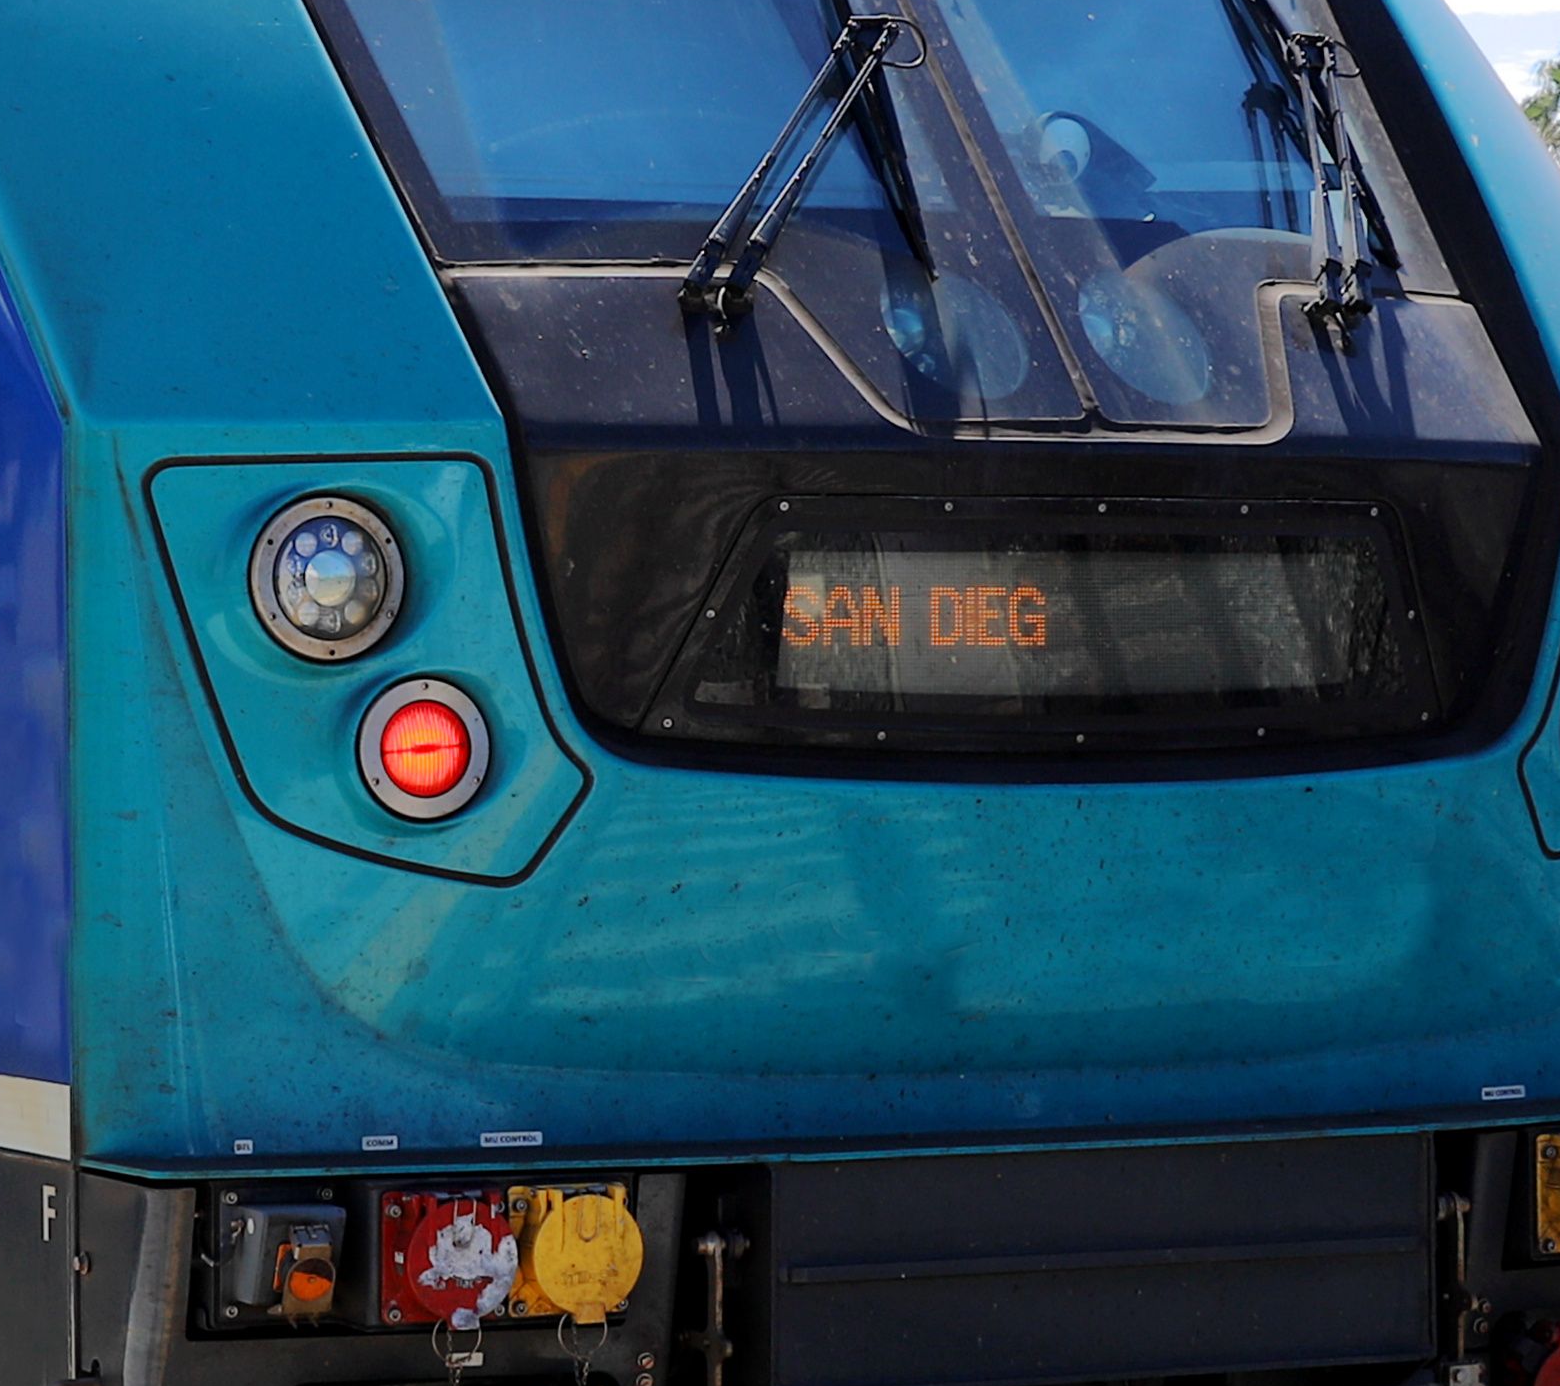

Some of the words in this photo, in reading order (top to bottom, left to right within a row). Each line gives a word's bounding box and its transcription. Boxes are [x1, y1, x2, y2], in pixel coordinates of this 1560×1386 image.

[782, 585, 900, 647] SAN
[930, 585, 1047, 647] DIEG
[366, 1139, 394, 1148] COMM
[484, 1136, 498, 1145] MU
[500, 1134, 538, 1144] CONTROL
[41, 1185, 58, 1242] F
